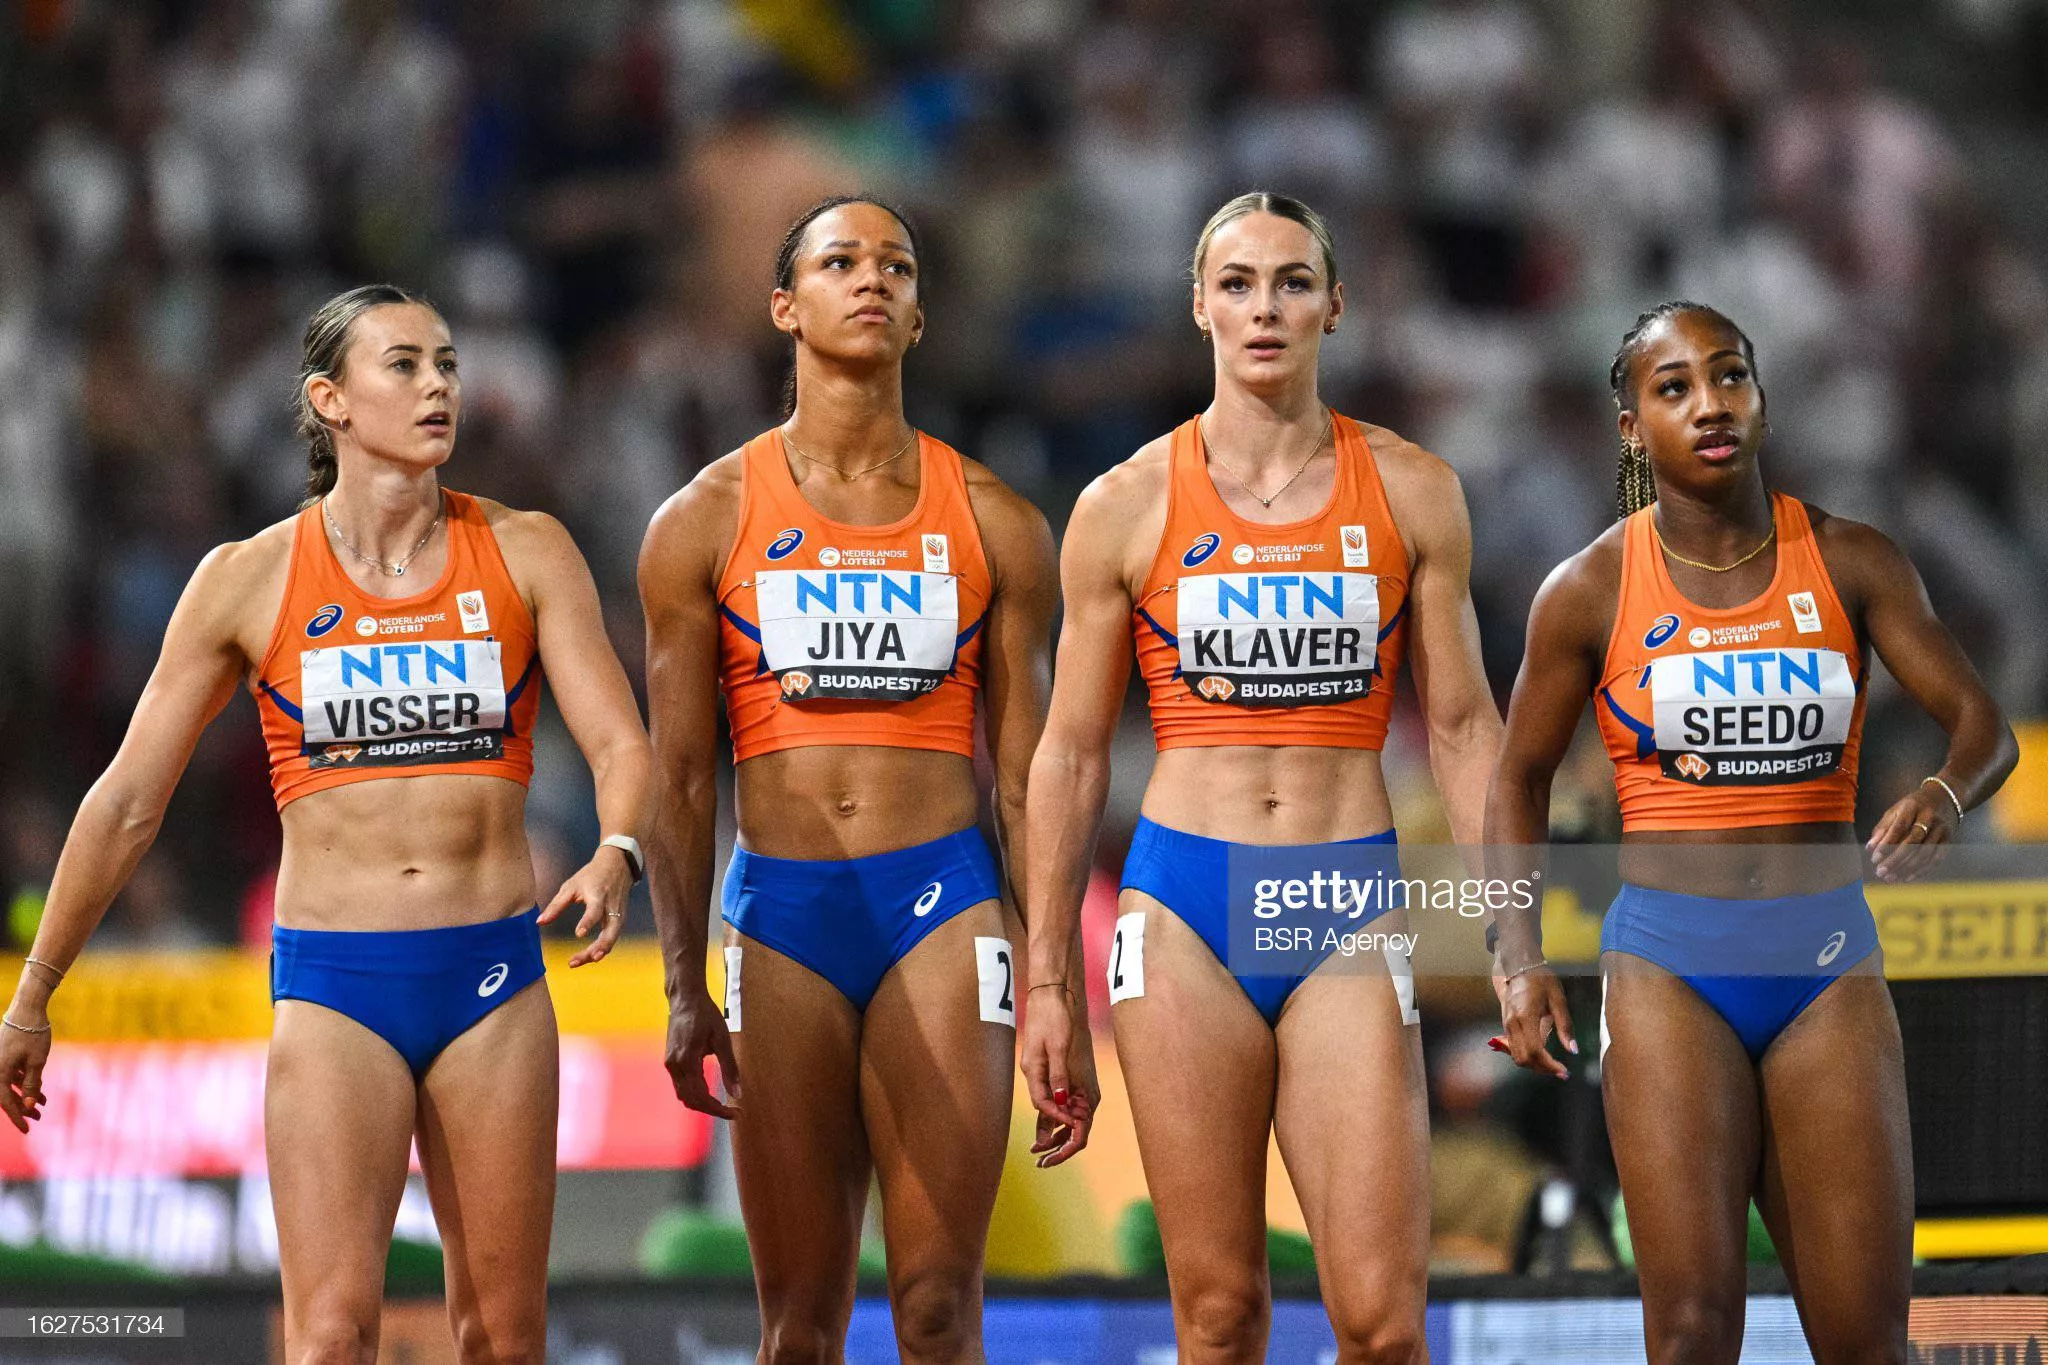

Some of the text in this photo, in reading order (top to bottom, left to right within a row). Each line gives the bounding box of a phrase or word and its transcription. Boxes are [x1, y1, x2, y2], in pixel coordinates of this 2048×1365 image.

[841, 549, 908, 559] NEDERLANDSE
[1256, 543, 1325, 554] NEDERLANDSE
[1256, 552, 1301, 563] LOTERIJ
[841, 557, 886, 566] LOTERIJ
[796, 573, 921, 615] NTN
[1218, 575, 1343, 620] NTN
[379, 612, 446, 626] NEDERLANDSE
[379, 624, 424, 635] LOTERIJ
[1712, 620, 1782, 636] NEDERLANDSE
[807, 622, 906, 661] JIYA
[1193, 627, 1361, 668] KLAVER
[1712, 632, 1759, 645] LOTERIJ
[340, 643, 467, 688] NTN
[1693, 652, 1821, 697] NTN
[818, 674, 921, 692] BUDAPEST
[1240, 678, 1363, 698] BUDAPEST 23
[324, 692, 480, 738] VISSER
[1683, 703, 1824, 746] SEEDO
[368, 735, 493, 756] BUDAPEST 23
[1717, 751, 1833, 776] BUDAPEST 23
[1879, 904, 2048, 964] SEI
[1113, 930, 1124, 990] 2
[997, 951, 1013, 1012] 2
